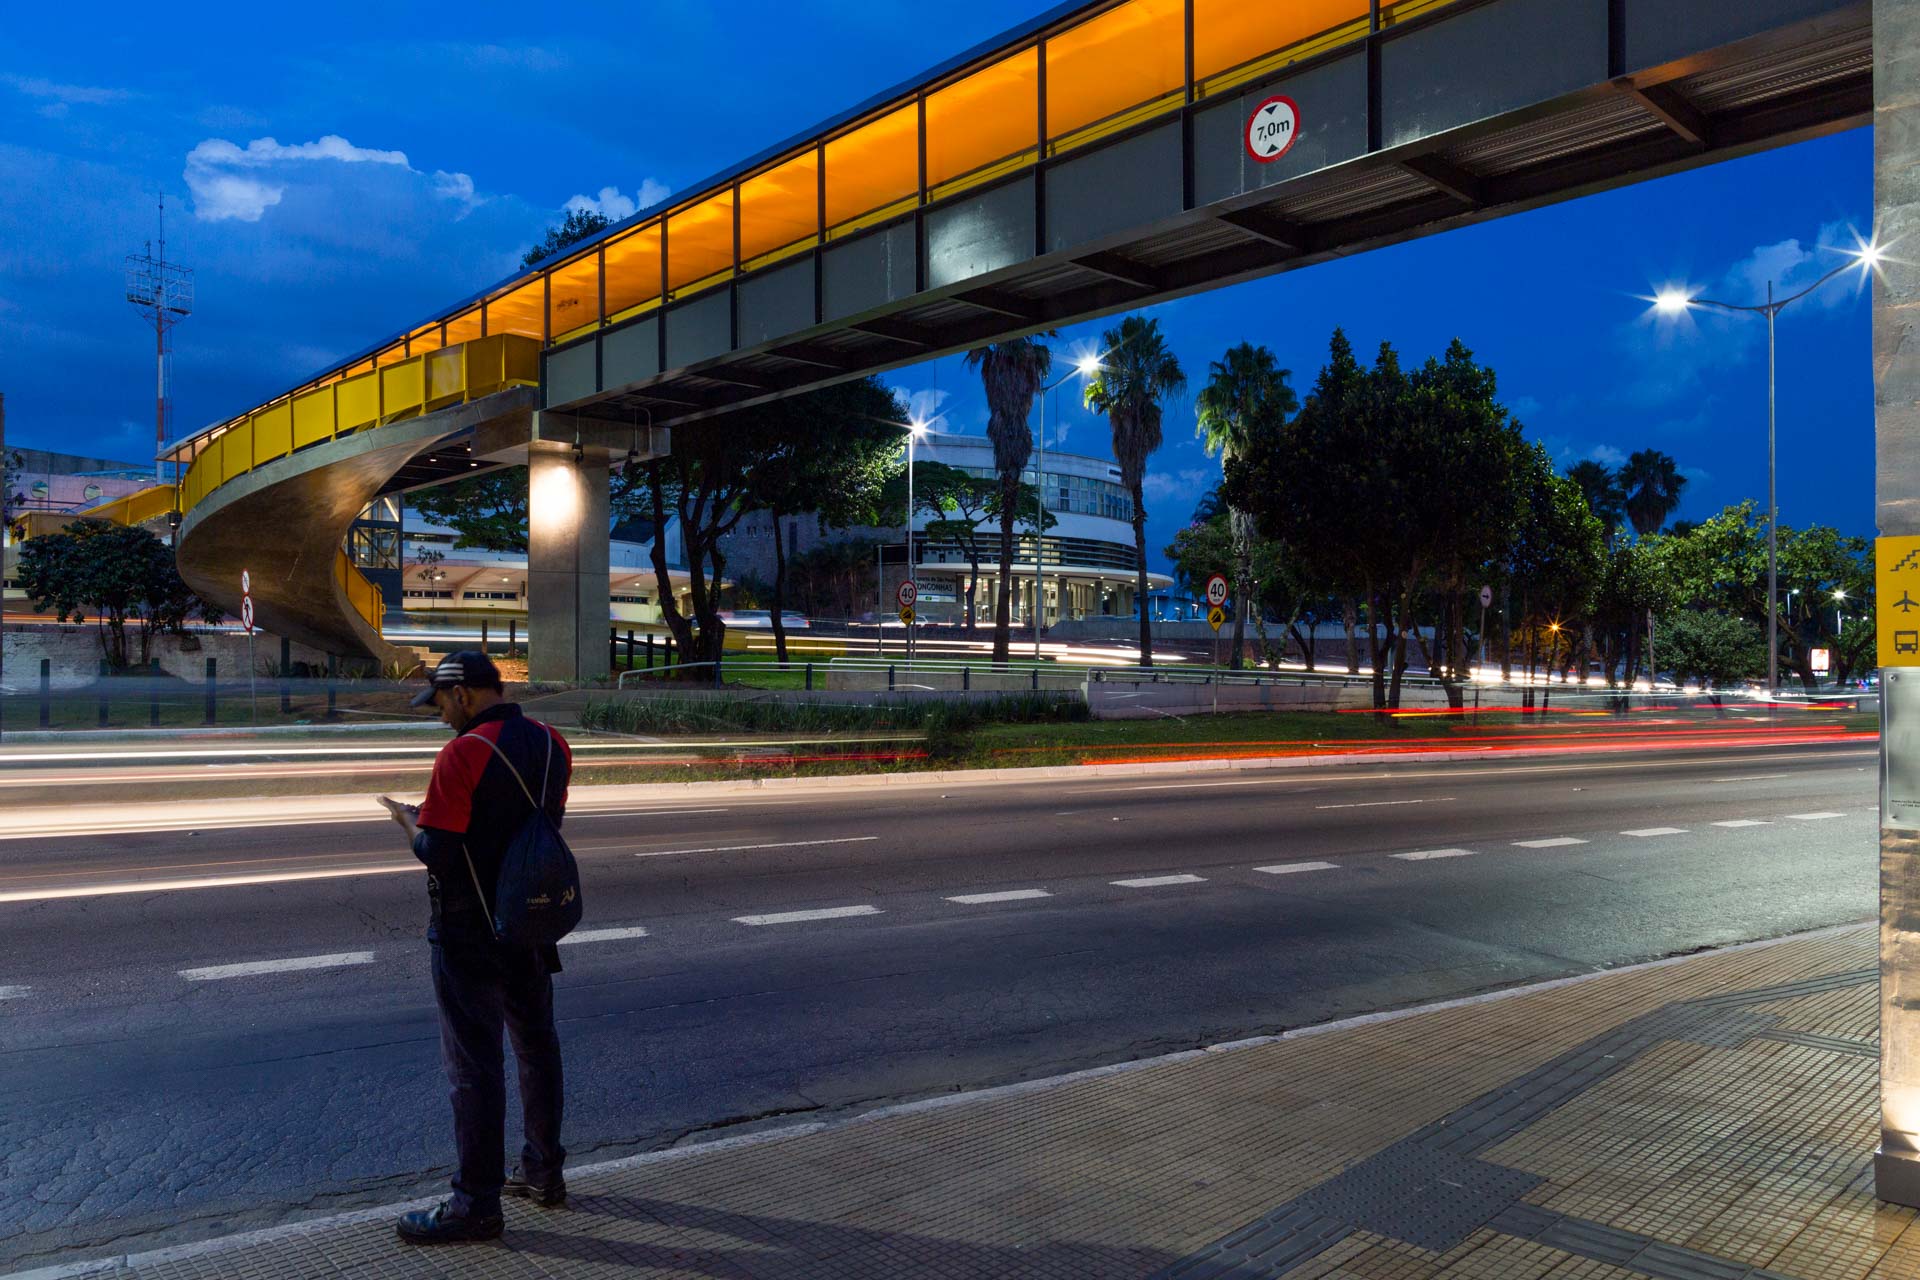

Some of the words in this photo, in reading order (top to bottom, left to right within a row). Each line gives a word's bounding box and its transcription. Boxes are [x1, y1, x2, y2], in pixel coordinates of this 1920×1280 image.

[1257, 120, 1290, 141] 7,0m
[902, 587, 914, 599] 40
[917, 582, 953, 592] ONGONHAS
[1211, 583, 1224, 597] 40
